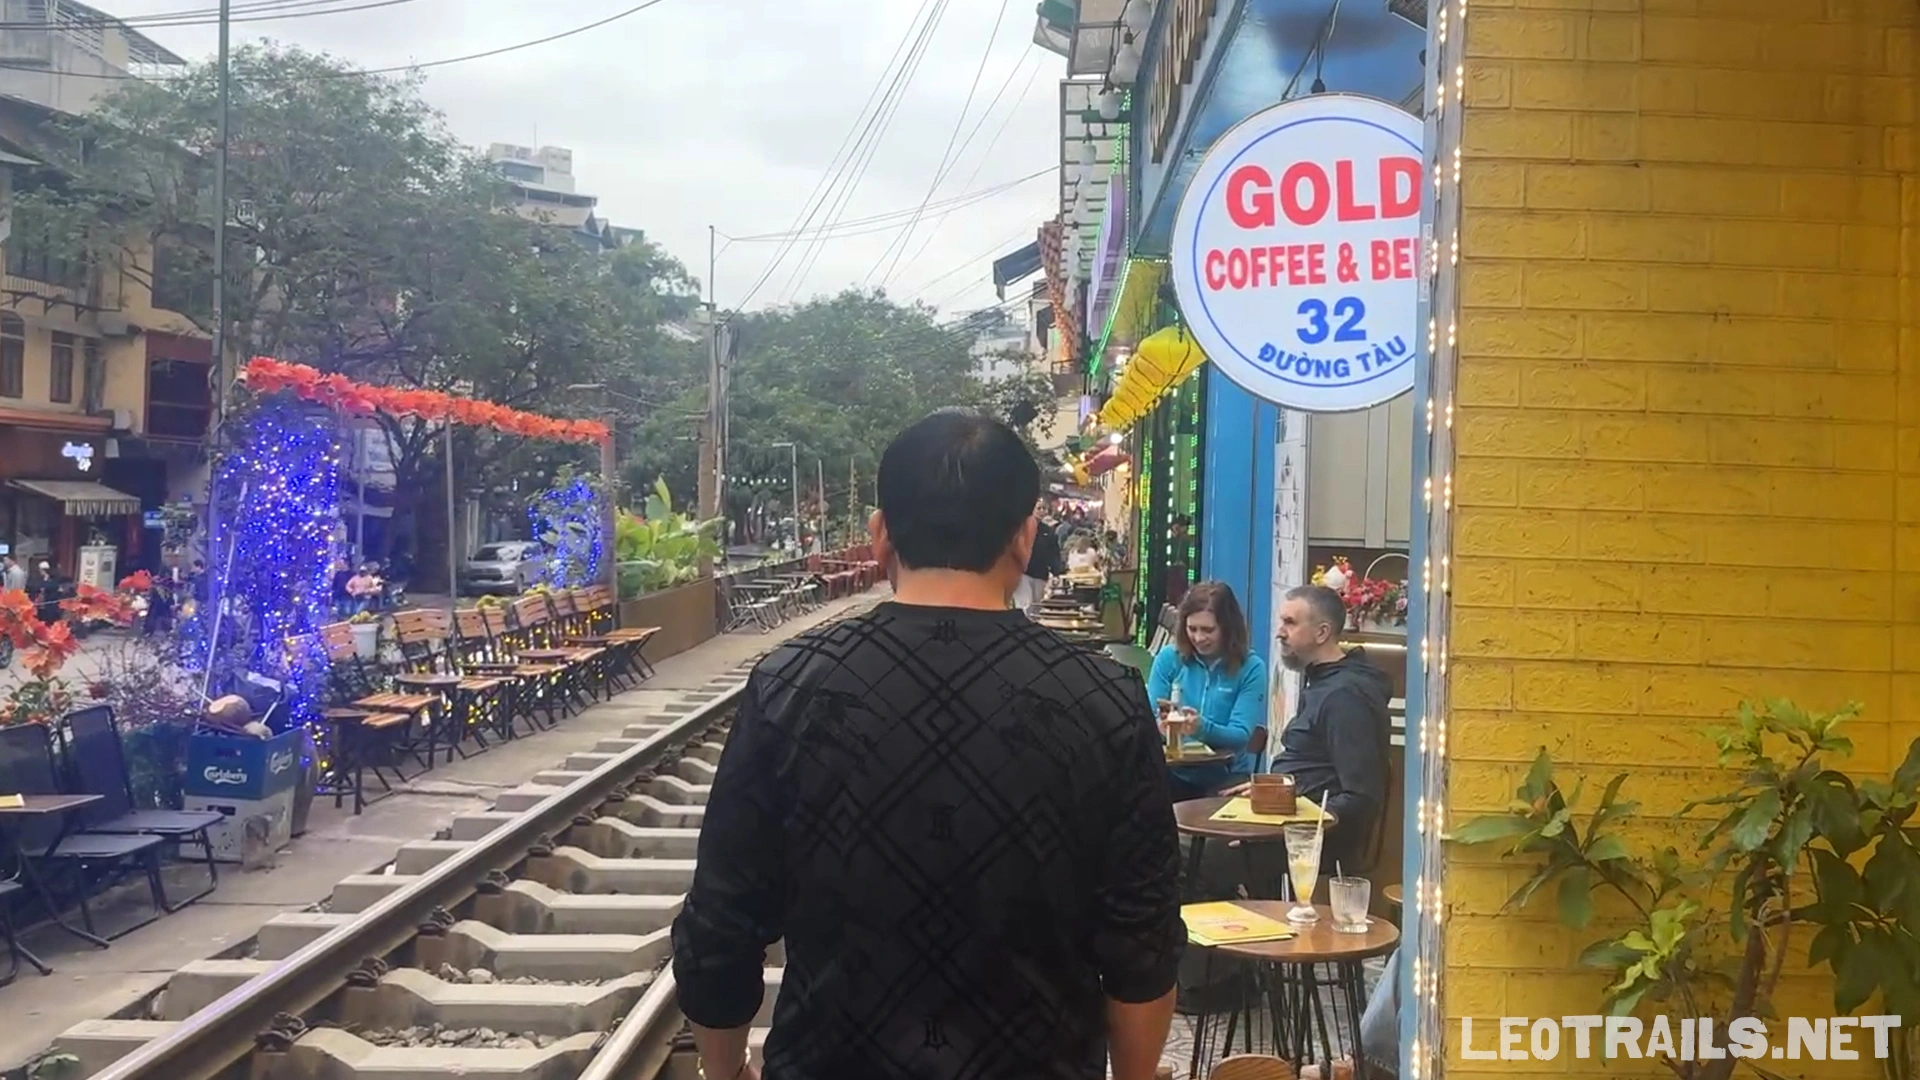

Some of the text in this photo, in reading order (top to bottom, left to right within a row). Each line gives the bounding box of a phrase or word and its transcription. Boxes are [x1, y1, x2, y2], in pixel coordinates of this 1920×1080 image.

[1226, 157, 1423, 229] GOLD
[1205, 244, 1326, 291] COFFEE
[1337, 242, 1360, 283] &
[1371, 238, 1420, 281] BE
[1296, 296, 1367, 344] 32
[1258, 334, 1407, 378] ĐƯỜNG TÀU
[204, 766, 247, 784] Carlsberg
